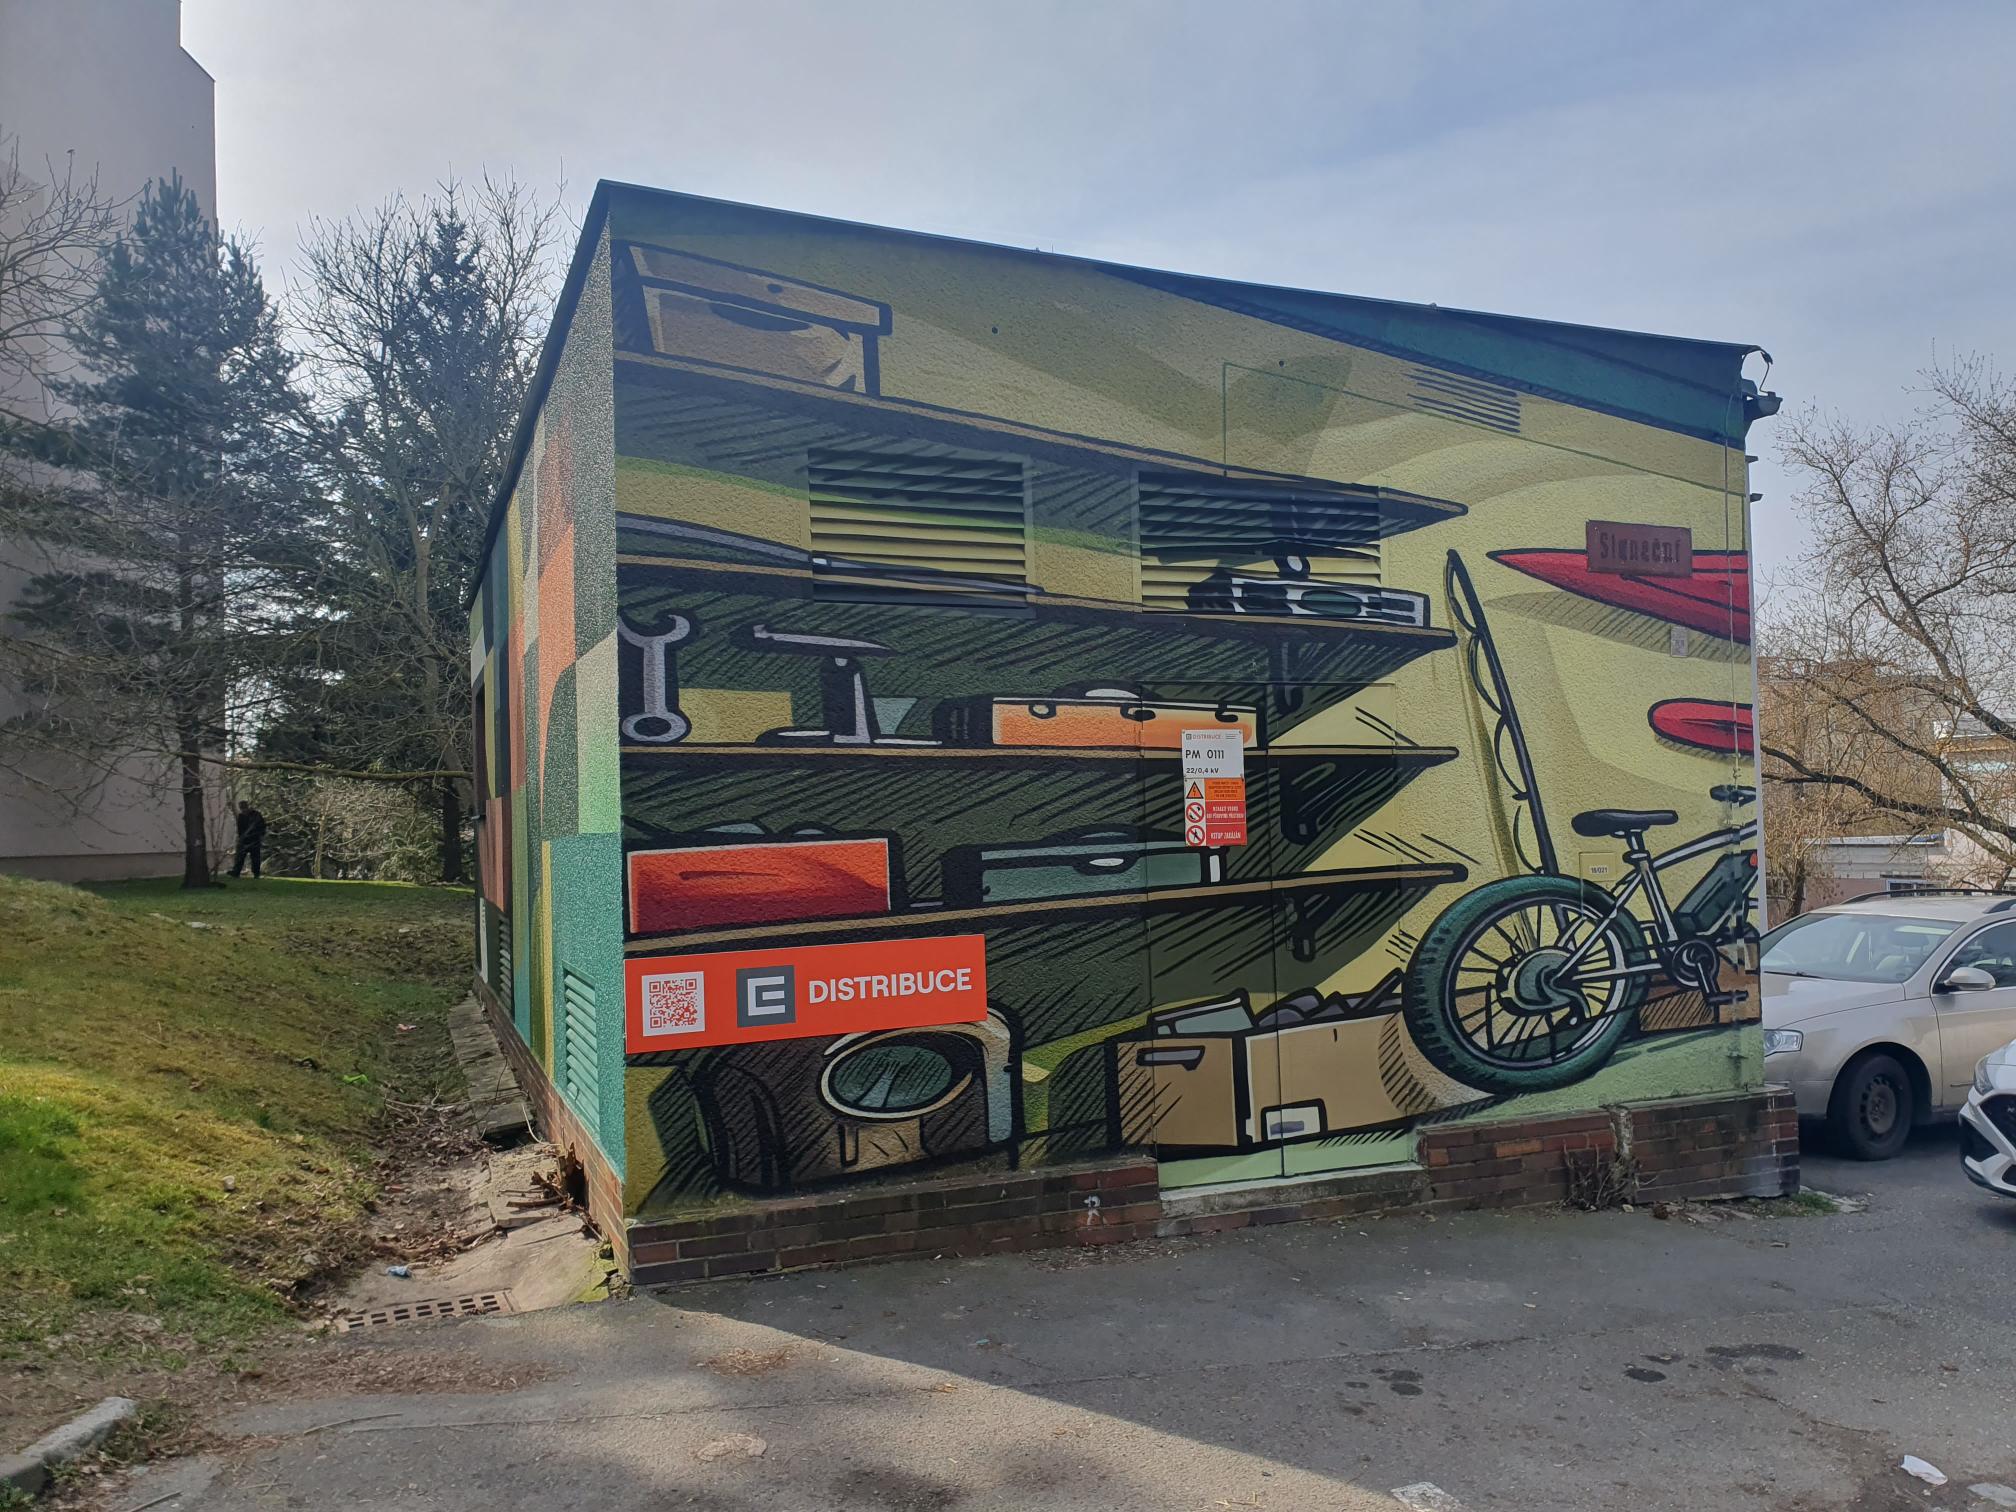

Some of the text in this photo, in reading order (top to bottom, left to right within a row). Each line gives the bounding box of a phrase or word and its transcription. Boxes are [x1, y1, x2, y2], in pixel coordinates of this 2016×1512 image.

[1185, 749, 1224, 759] PM 0111
[1185, 767, 1209, 775] 22/0,4
[809, 968, 972, 1004] DISTRIBUCE
